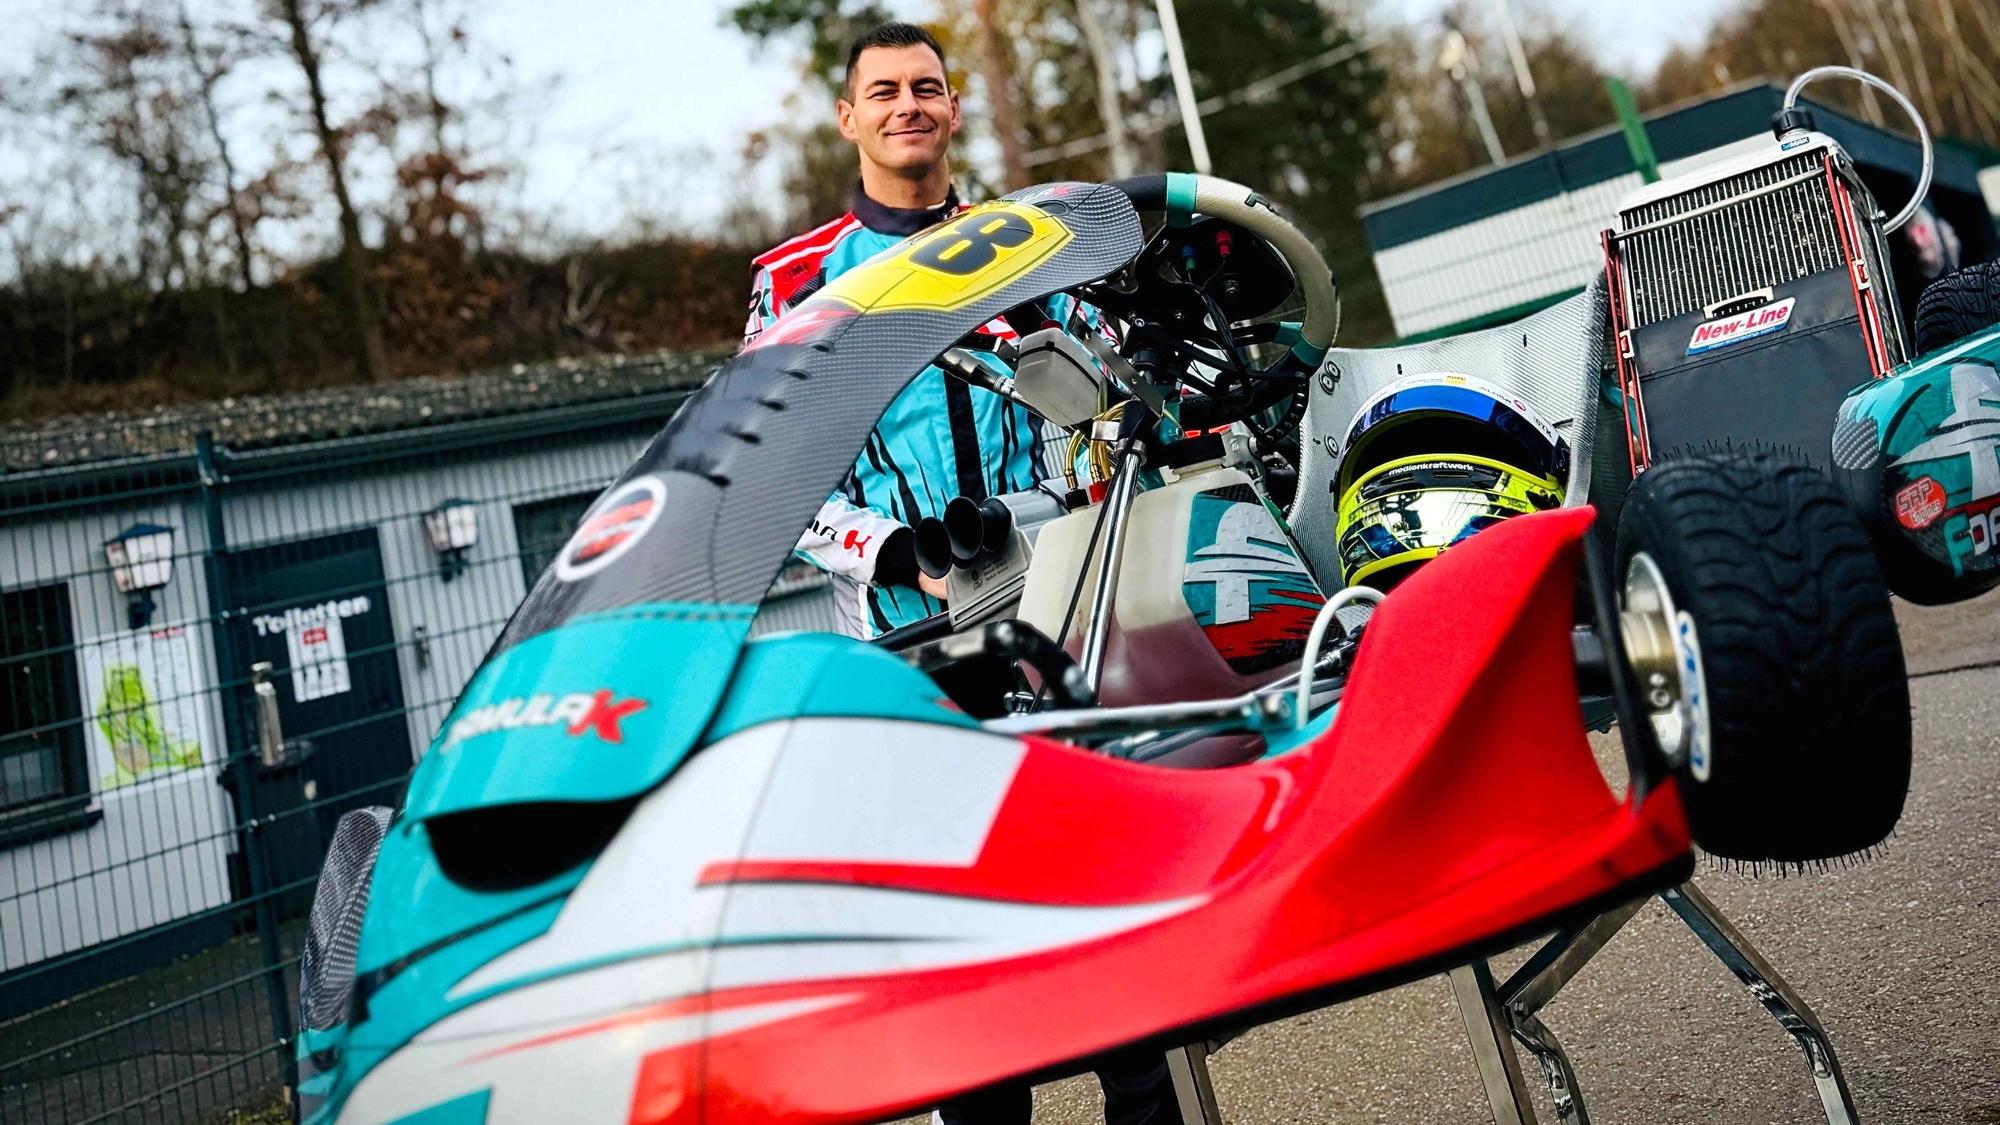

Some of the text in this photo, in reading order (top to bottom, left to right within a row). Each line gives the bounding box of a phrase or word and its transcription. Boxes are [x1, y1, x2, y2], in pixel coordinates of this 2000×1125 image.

[909, 211, 1034, 276] 8
[1695, 305, 1789, 343] New-Line
[1388, 462, 1474, 476] medienkraftwerk
[1896, 478, 1933, 515] SRP
[1911, 500, 1942, 526] Engines
[252, 596, 371, 636] Toiletten
